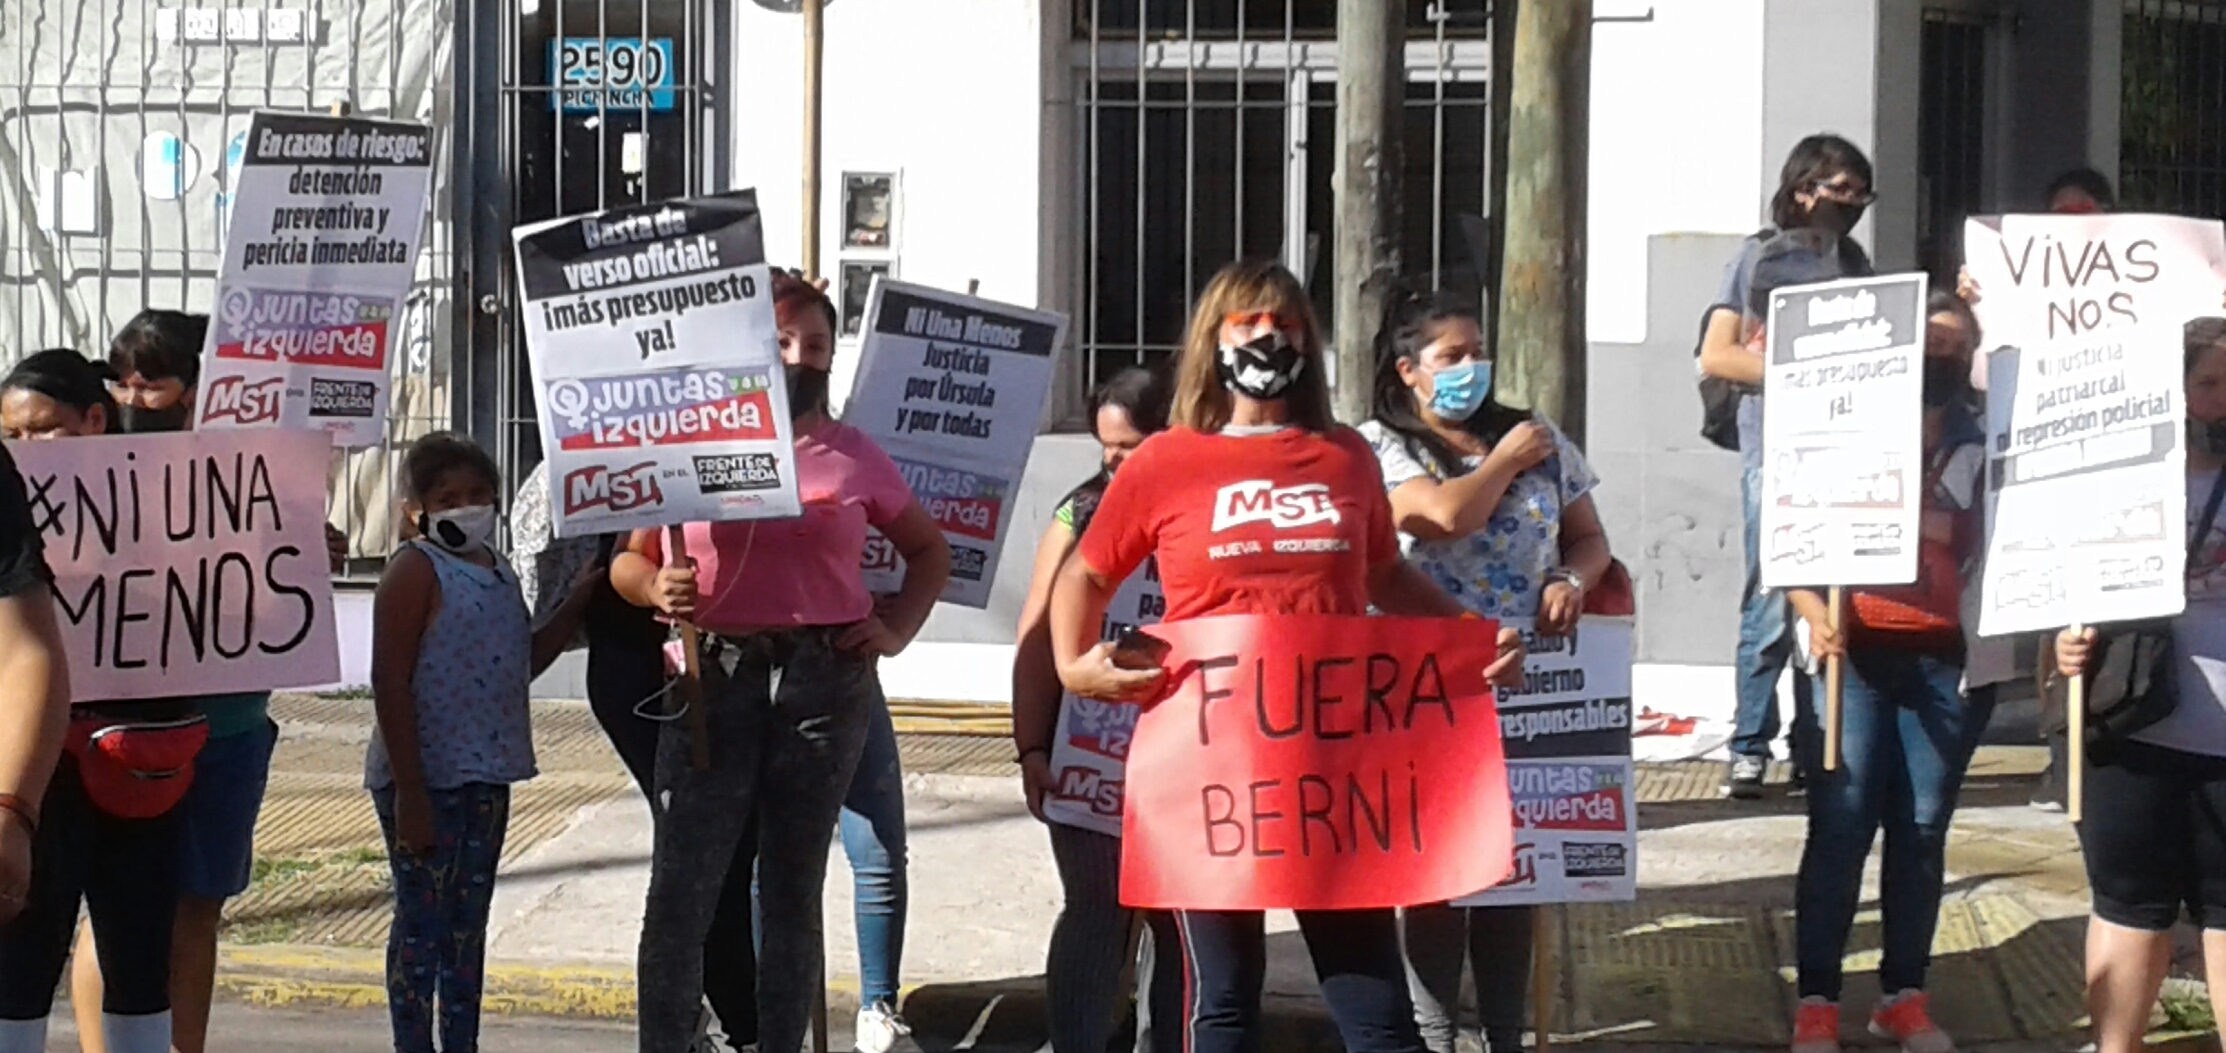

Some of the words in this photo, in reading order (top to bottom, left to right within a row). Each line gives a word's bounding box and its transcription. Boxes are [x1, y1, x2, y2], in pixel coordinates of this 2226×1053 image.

[562, 46, 662, 85] 2590
[257, 129, 280, 157] En
[283, 134, 333, 157] casos
[336, 130, 359, 157] de
[361, 129, 426, 163] riesgo:
[289, 165, 382, 195] detención
[271, 202, 374, 235] preventiva
[377, 207, 391, 234] y
[582, 214, 652, 249] Basta
[654, 206, 688, 236] de
[242, 236, 308, 270] pericia
[311, 237, 408, 265] inmediata
[562, 254, 632, 291] verso
[634, 233, 720, 280] oficial:
[607, 273, 756, 327] presupuesto
[2048, 290, 2138, 340] NOS
[242, 321, 378, 362] izquierda
[635, 319, 676, 360] ya!
[904, 307, 926, 334] Ni
[926, 310, 962, 339] Una
[963, 316, 1023, 349] Menos
[923, 341, 991, 376] Justicia
[904, 375, 938, 402] por
[2036, 369, 2126, 416] patriarcal
[592, 398, 761, 445] izquierda
[894, 405, 909, 432] y
[908, 410, 941, 434] por
[943, 411, 993, 440] todas
[2016, 407, 2098, 450] represión
[2102, 388, 2170, 432] policial
[164, 452, 282, 542] UNA
[861, 539, 895, 566] ST
[1208, 540, 1262, 560] NUEVA
[1197, 653, 1454, 746] FUERA
[1510, 766, 1593, 795] untas
[1515, 793, 1616, 832] quierda
